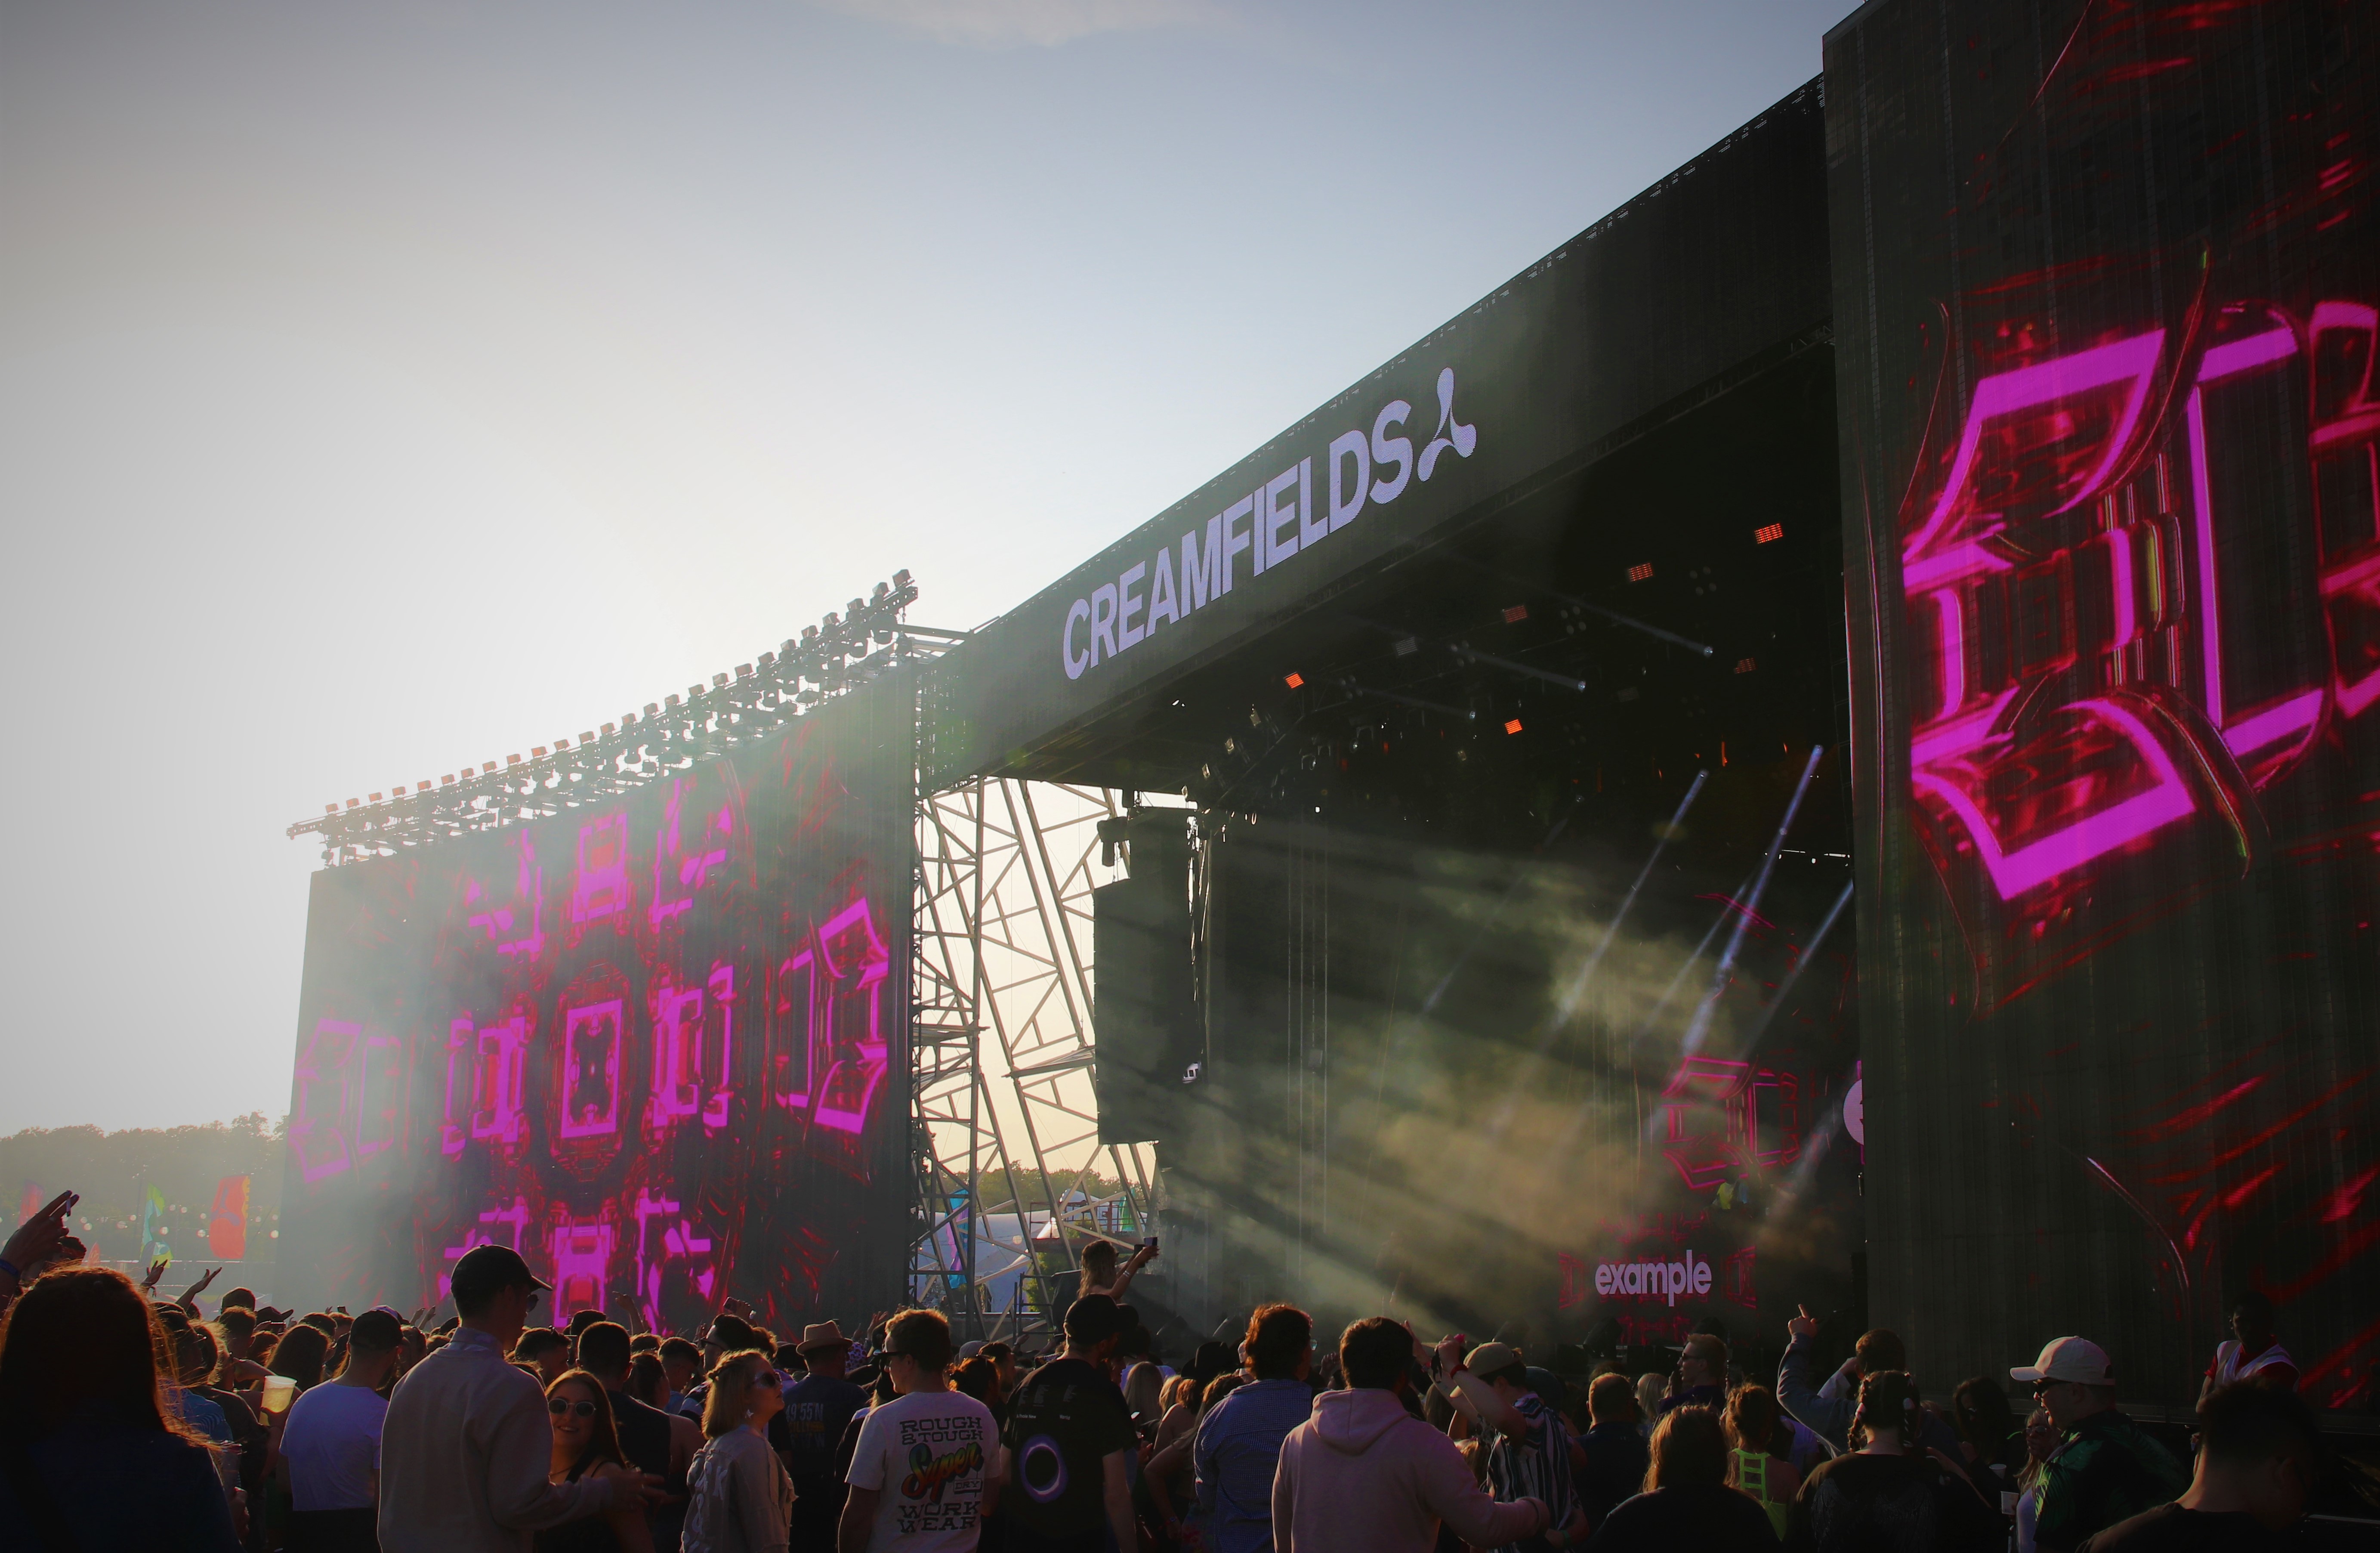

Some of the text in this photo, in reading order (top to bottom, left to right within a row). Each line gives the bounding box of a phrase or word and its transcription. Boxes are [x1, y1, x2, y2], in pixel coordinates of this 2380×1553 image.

[1063, 399, 1413, 681] CREAMFIELDS
[1595, 1250, 1712, 1307] example
[899, 1417, 982, 1433] ROUGH
[901, 1442, 984, 1505] Super
[955, 1481, 980, 1490] DRY
[898, 1501, 981, 1519] WORK
[897, 1516, 976, 1533] WEAR
